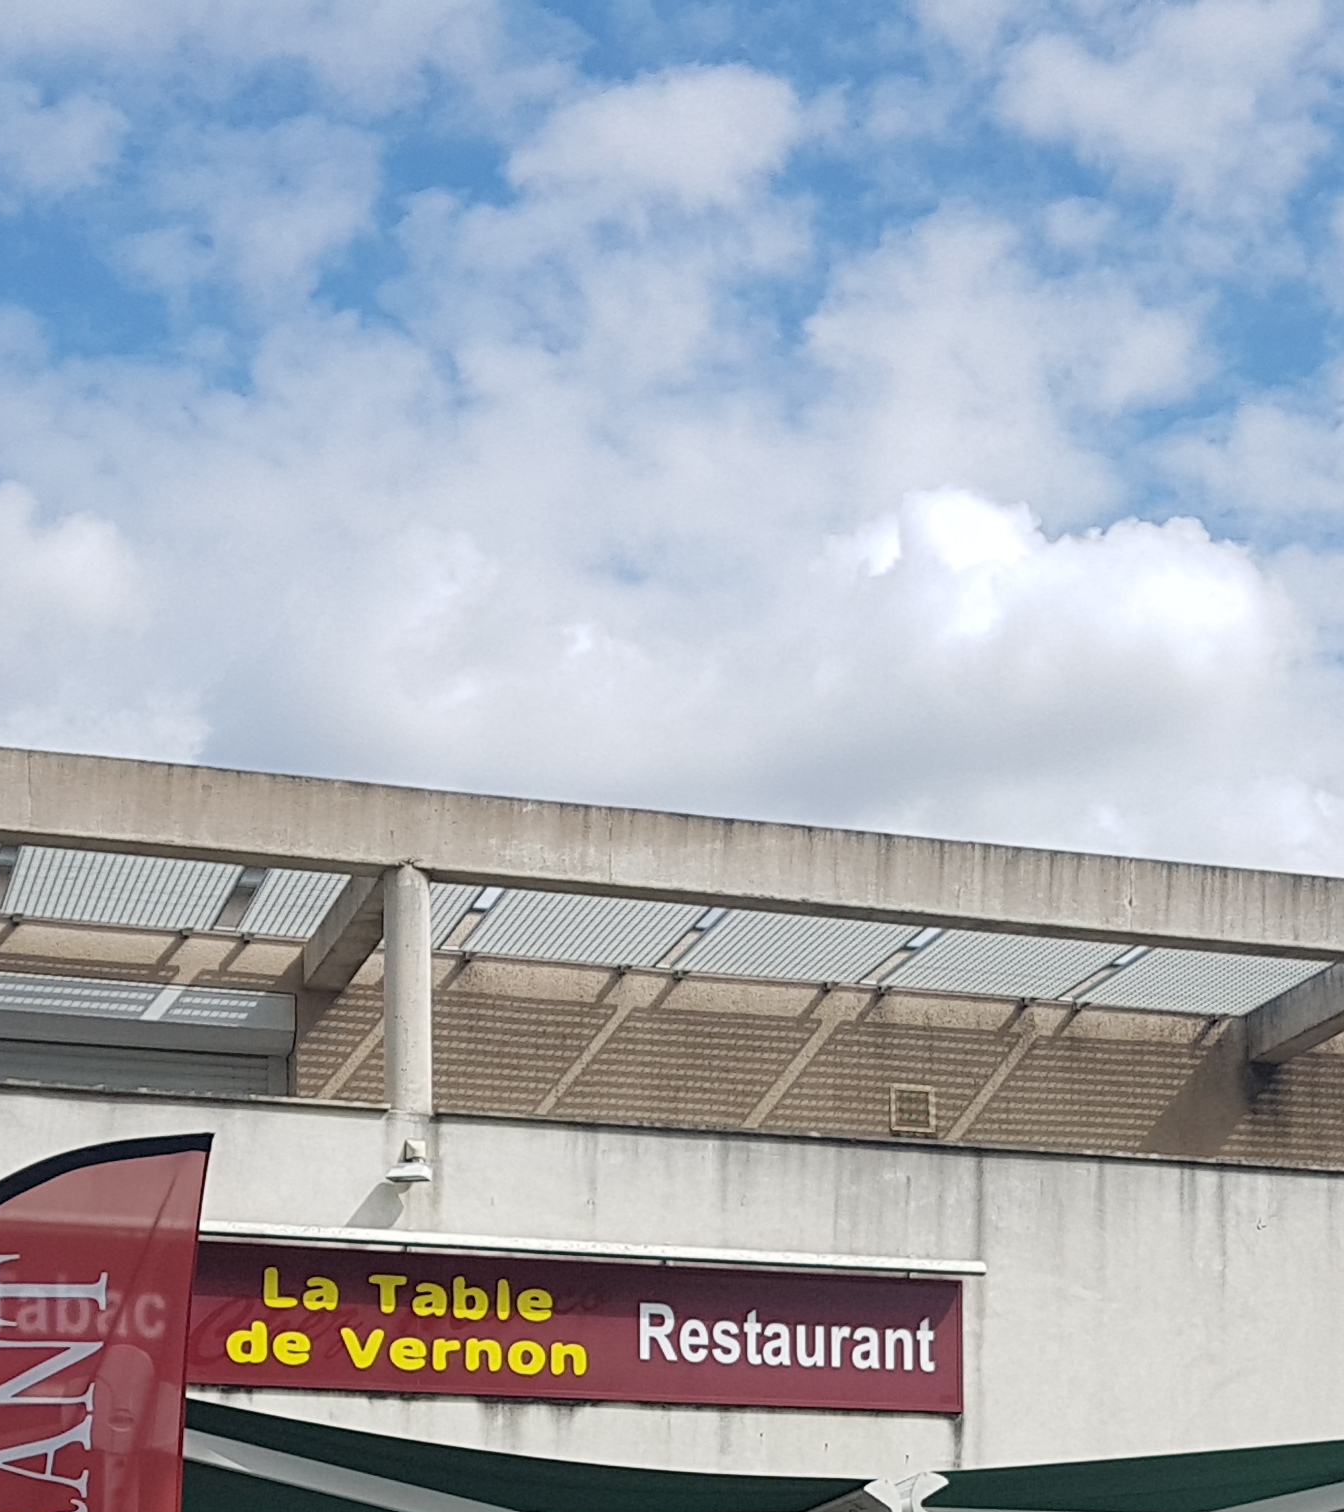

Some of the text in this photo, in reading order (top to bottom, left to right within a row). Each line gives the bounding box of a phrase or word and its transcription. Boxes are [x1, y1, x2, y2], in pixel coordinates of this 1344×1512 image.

[262, 1266, 339, 1311] La
[368, 1274, 553, 1321] Table
[226, 1321, 588, 1376] de Vernon
[639, 1302, 936, 1373] Restaurant
